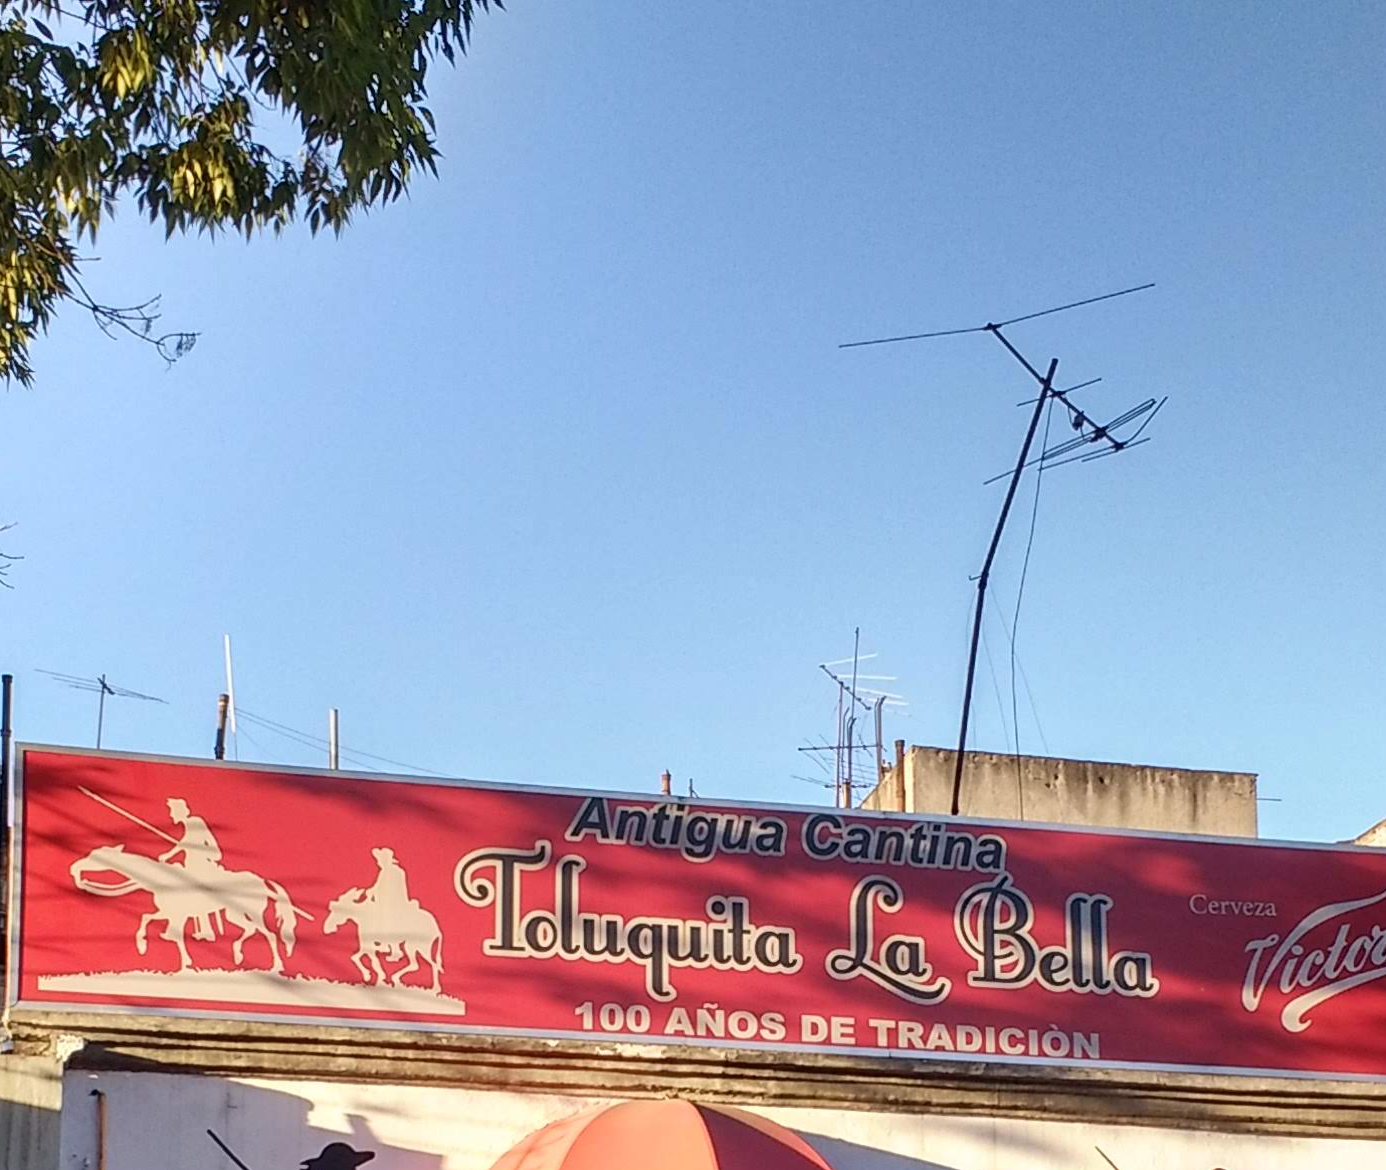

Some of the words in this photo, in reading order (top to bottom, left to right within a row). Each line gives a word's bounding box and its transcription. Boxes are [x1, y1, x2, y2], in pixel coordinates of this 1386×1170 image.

[566, 796, 787, 863] Antigua
[801, 812, 1007, 872] Cantina
[454, 840, 803, 1001] Toluquita
[826, 873, 951, 1005] La
[954, 872, 1160, 998] Bella
[1188, 893, 1277, 919] Cerveza
[574, 1002, 651, 1036] 100
[665, 1002, 787, 1042] AÑOS
[802, 1015, 857, 1046] DE
